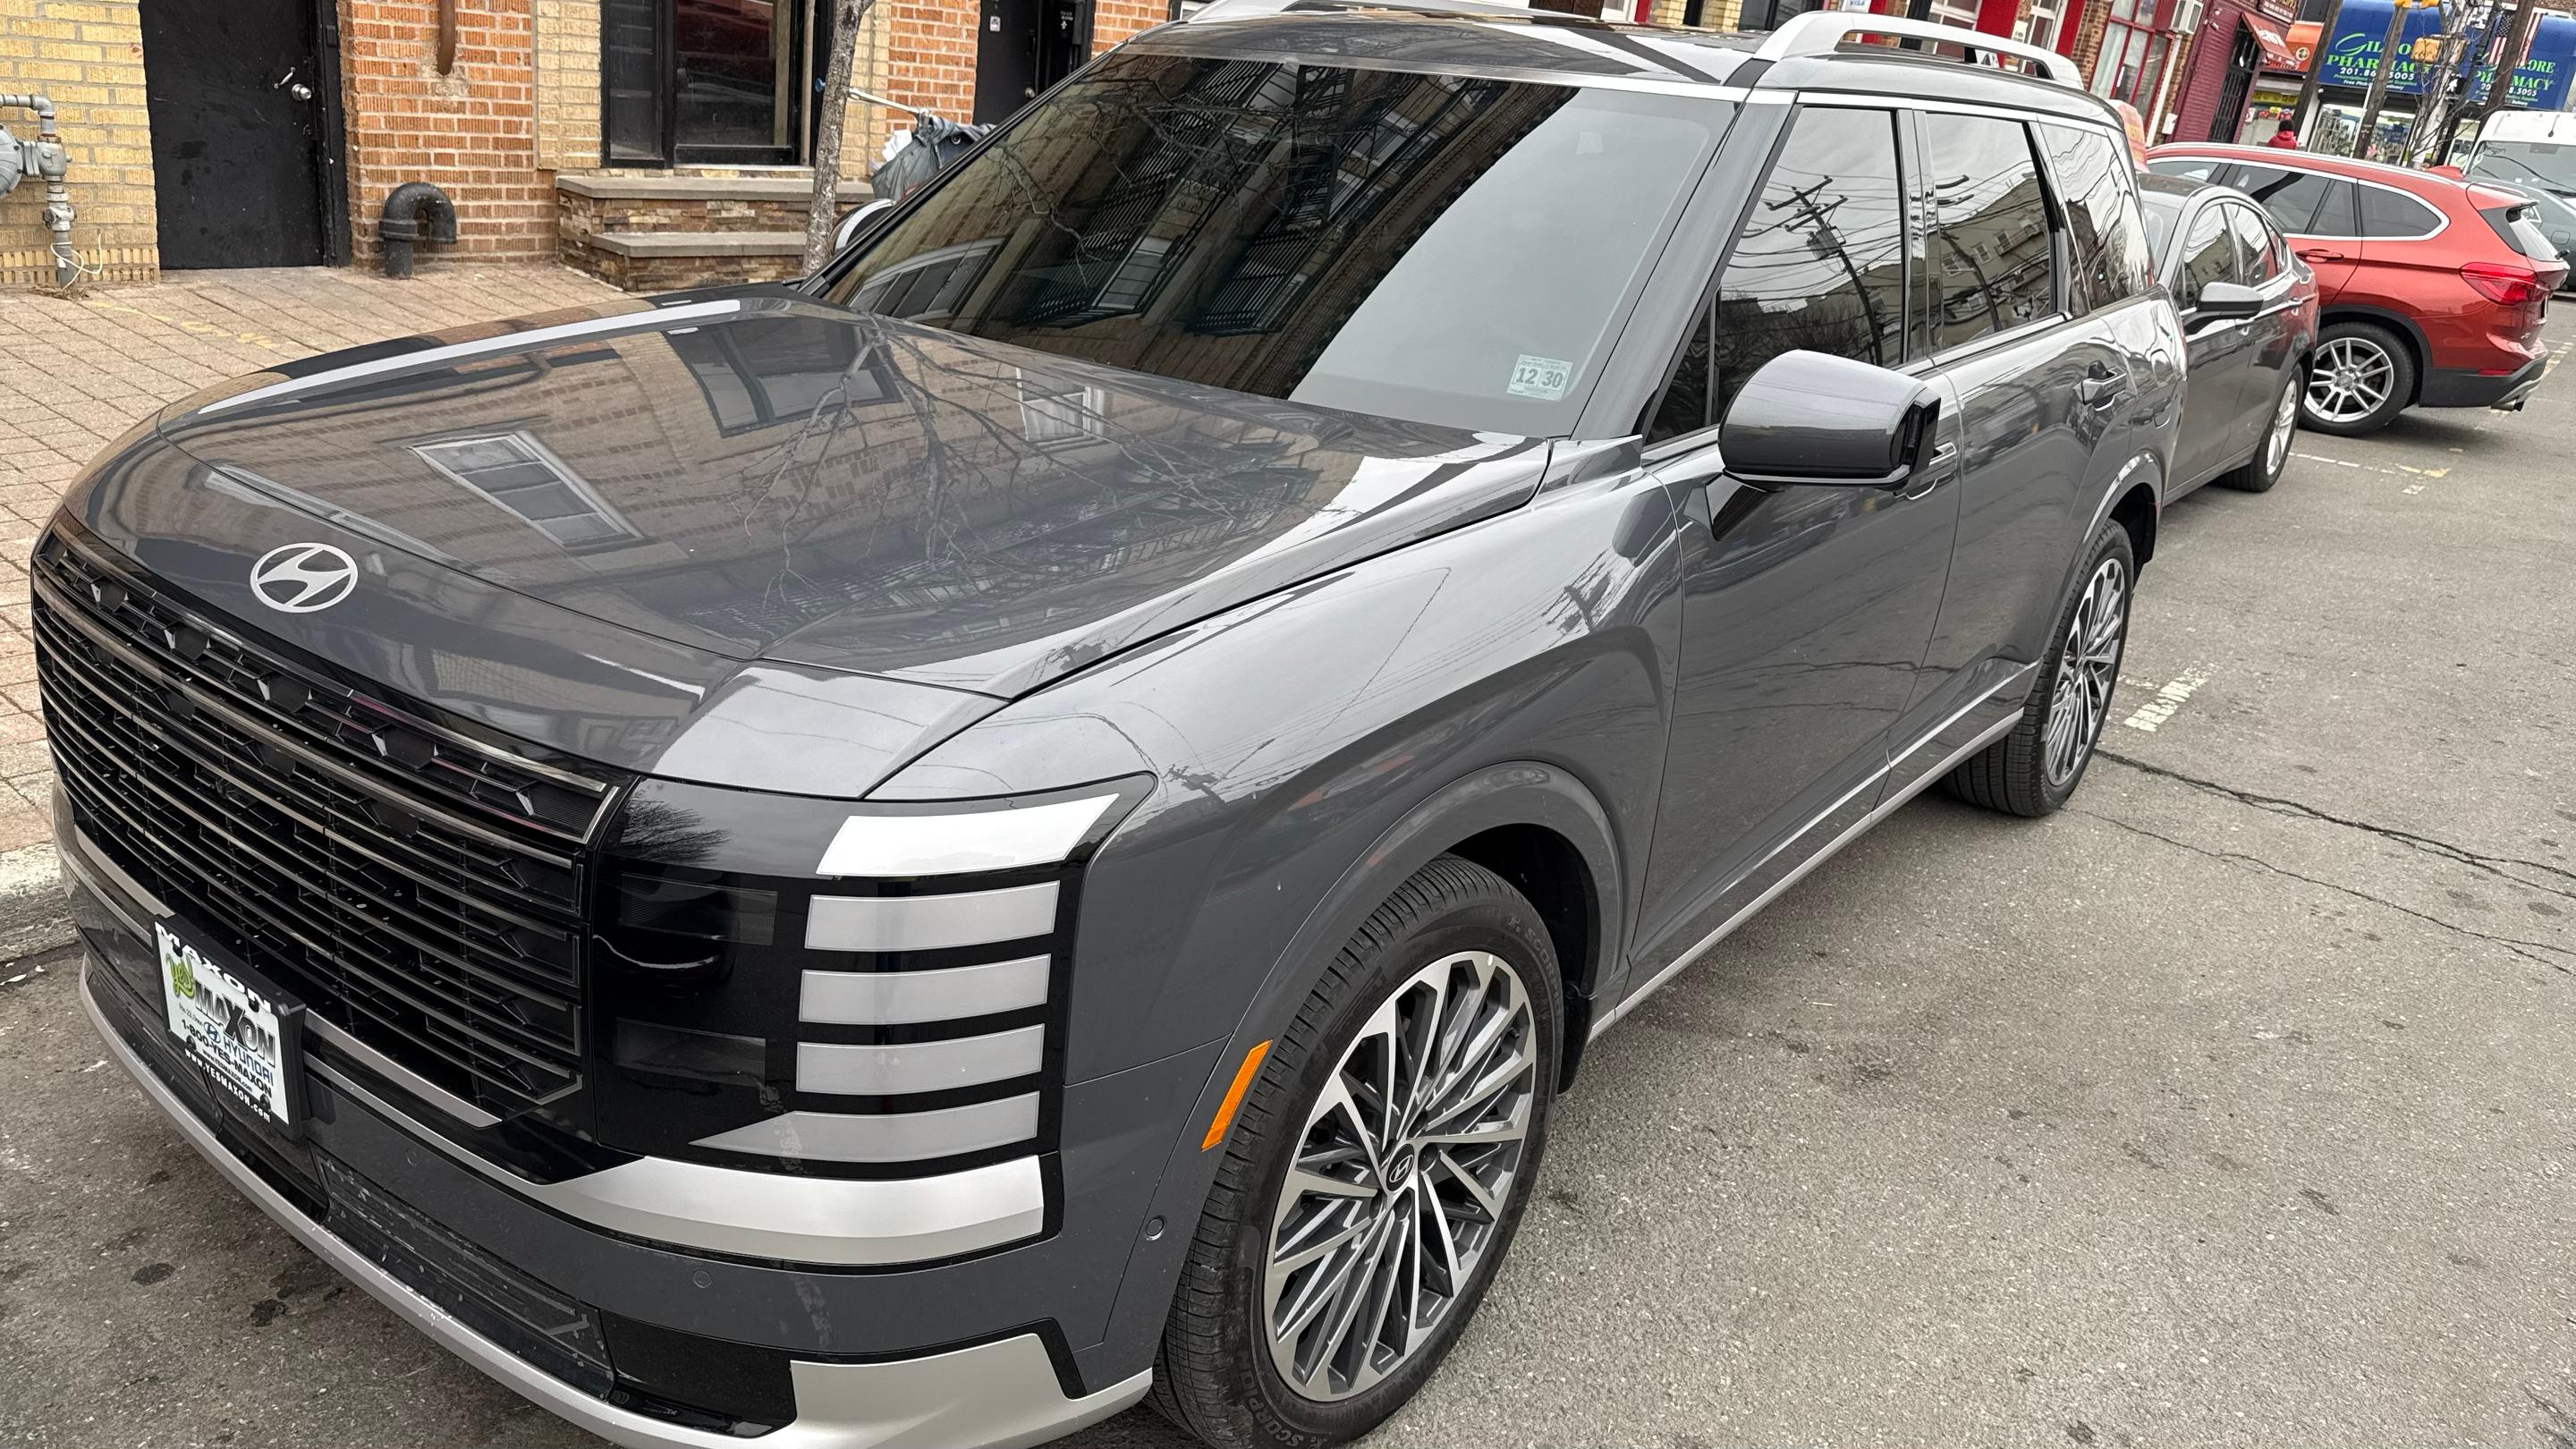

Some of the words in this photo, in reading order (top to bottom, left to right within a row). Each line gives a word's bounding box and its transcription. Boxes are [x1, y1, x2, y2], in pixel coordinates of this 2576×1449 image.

[2339, 67, 2414, 80] 201.865005
[1515, 367, 1538, 386] 12
[1542, 370, 1563, 388] 30
[155, 921, 271, 1013] MAXON
[182, 1019, 272, 1098] 1-800-YES-MAXON
[194, 978, 275, 1069] MAXON
[223, 1035, 274, 1087] HYUNDAI
[184, 1048, 271, 1123] www.YESMAXON.com
